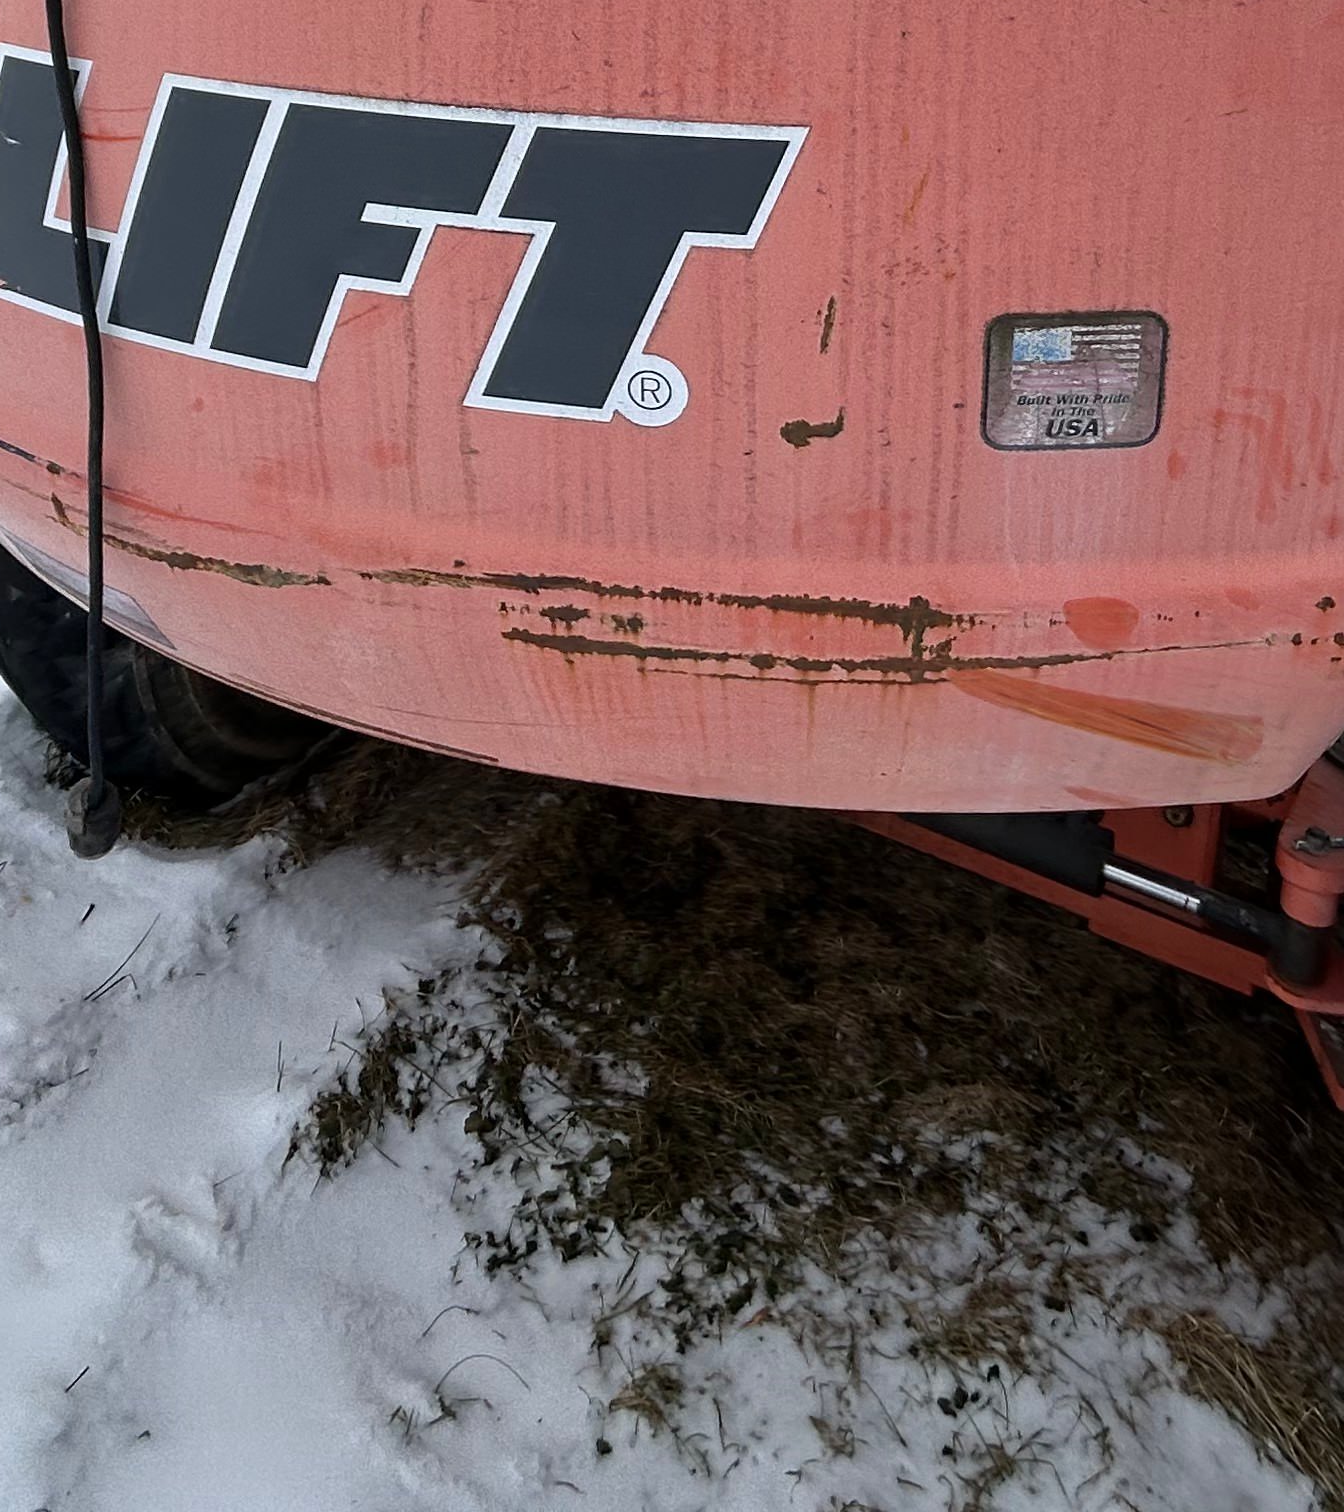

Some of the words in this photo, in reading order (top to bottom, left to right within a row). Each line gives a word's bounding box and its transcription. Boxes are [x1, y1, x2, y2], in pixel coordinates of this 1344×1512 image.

[1017, 395, 1051, 406] Built
[1056, 393, 1089, 405] With
[1093, 393, 1131, 405] Pride
[1070, 406, 1096, 417] The
[1046, 418, 1099, 438] USA
